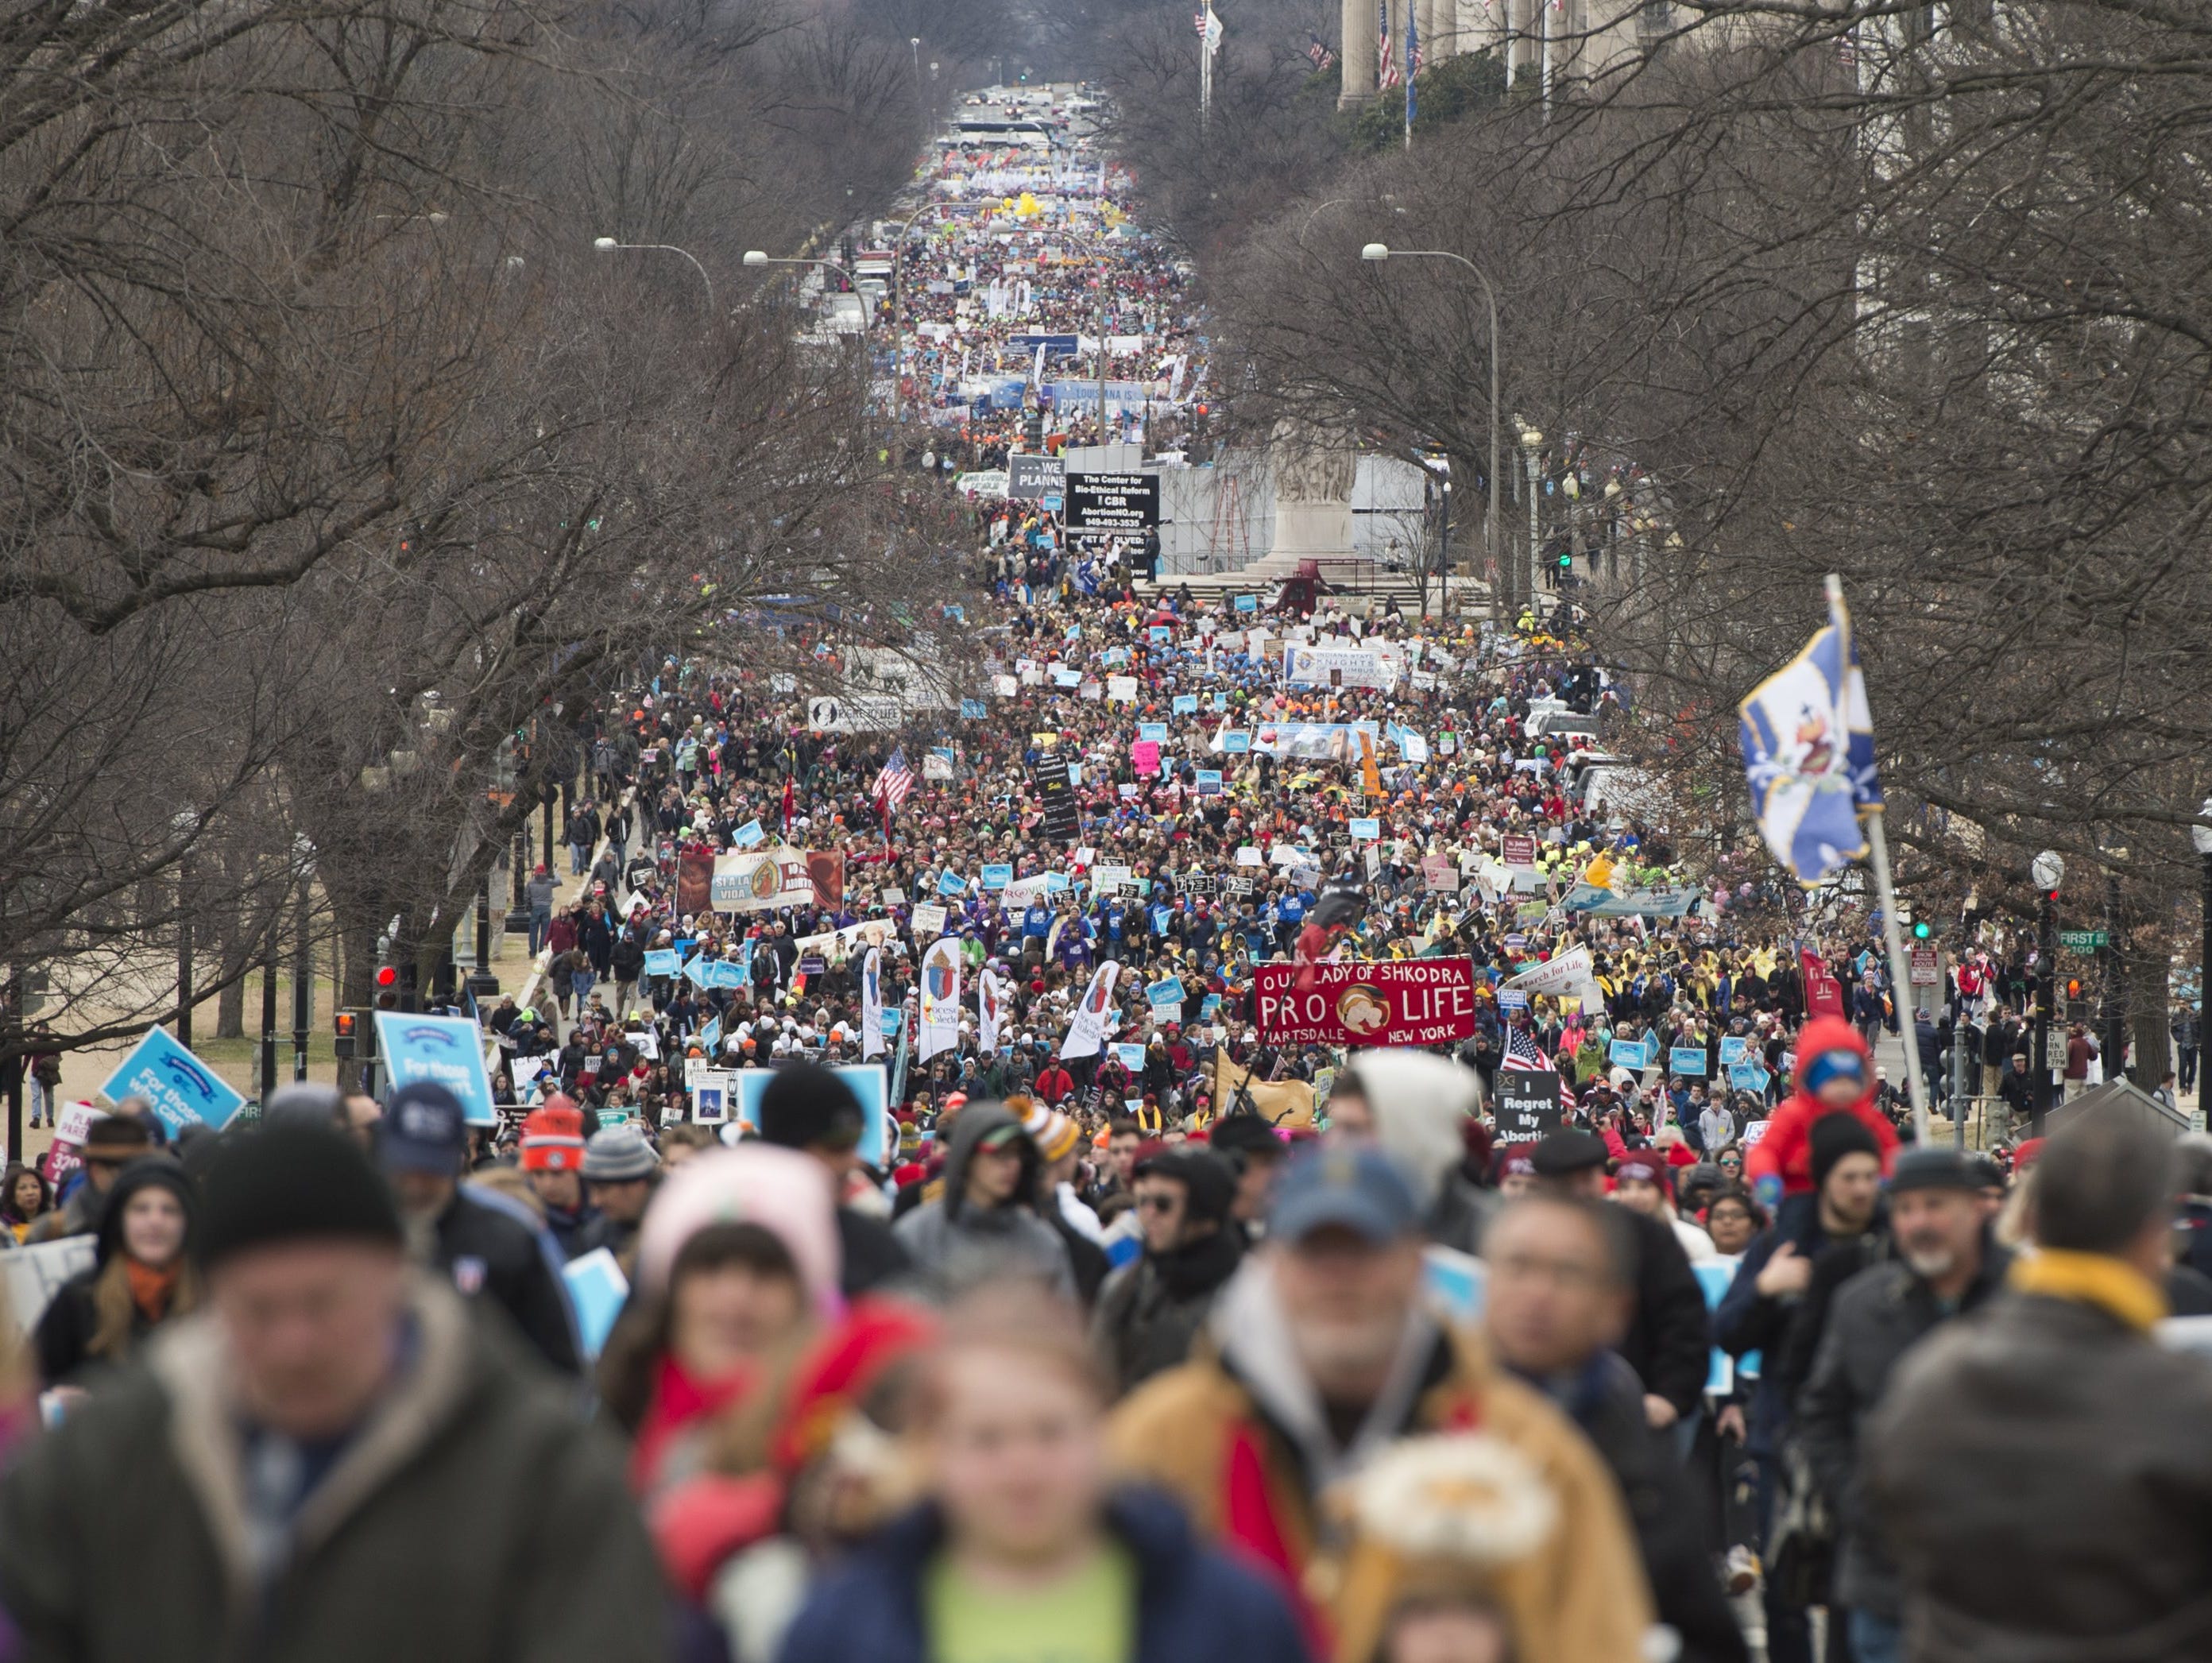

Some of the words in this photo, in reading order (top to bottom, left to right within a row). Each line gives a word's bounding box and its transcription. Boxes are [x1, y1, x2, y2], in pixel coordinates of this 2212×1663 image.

[1076, 389, 1122, 400] LOUISANA
[1042, 462, 1062, 474] WE
[1019, 475, 1066, 487] PLANNE
[1101, 476, 1128, 485] Center
[1075, 485, 1119, 494] Bio-Ethical
[1121, 486, 1150, 495] Reform
[1104, 496, 1127, 506] CBR
[1081, 508, 1144, 519] AbortionNO.org
[1085, 518, 1139, 527] 949-493-3535
[880, 709, 898, 718] LIFE
[716, 877, 726, 887] SI
[729, 877, 736, 887] A
[737, 876, 750, 885] LA
[720, 889, 745, 899] VIDA
[2060, 933, 2094, 944] FIRST
[1551, 965, 1564, 976] for
[1567, 960, 1583, 971] Life
[1356, 966, 1375, 980] OF
[1381, 965, 1465, 984] SHKODRA
[1261, 993, 1326, 1027] PRO
[1402, 985, 1473, 1022] LIFE
[1389, 1028, 1414, 1043] NEW
[1419, 1023, 1456, 1041] YORK
[129, 1077, 159, 1106] who
[1526, 1081, 1530, 1093] I
[140, 1067, 165, 1092] For
[164, 1089, 203, 1123] those
[1504, 1097, 1553, 1112] Regret
[73, 1112, 93, 1127] PLA
[1519, 1114, 1540, 1128] My
[62, 1122, 87, 1139] PARE
[1500, 1130, 1549, 1142] Aborti
